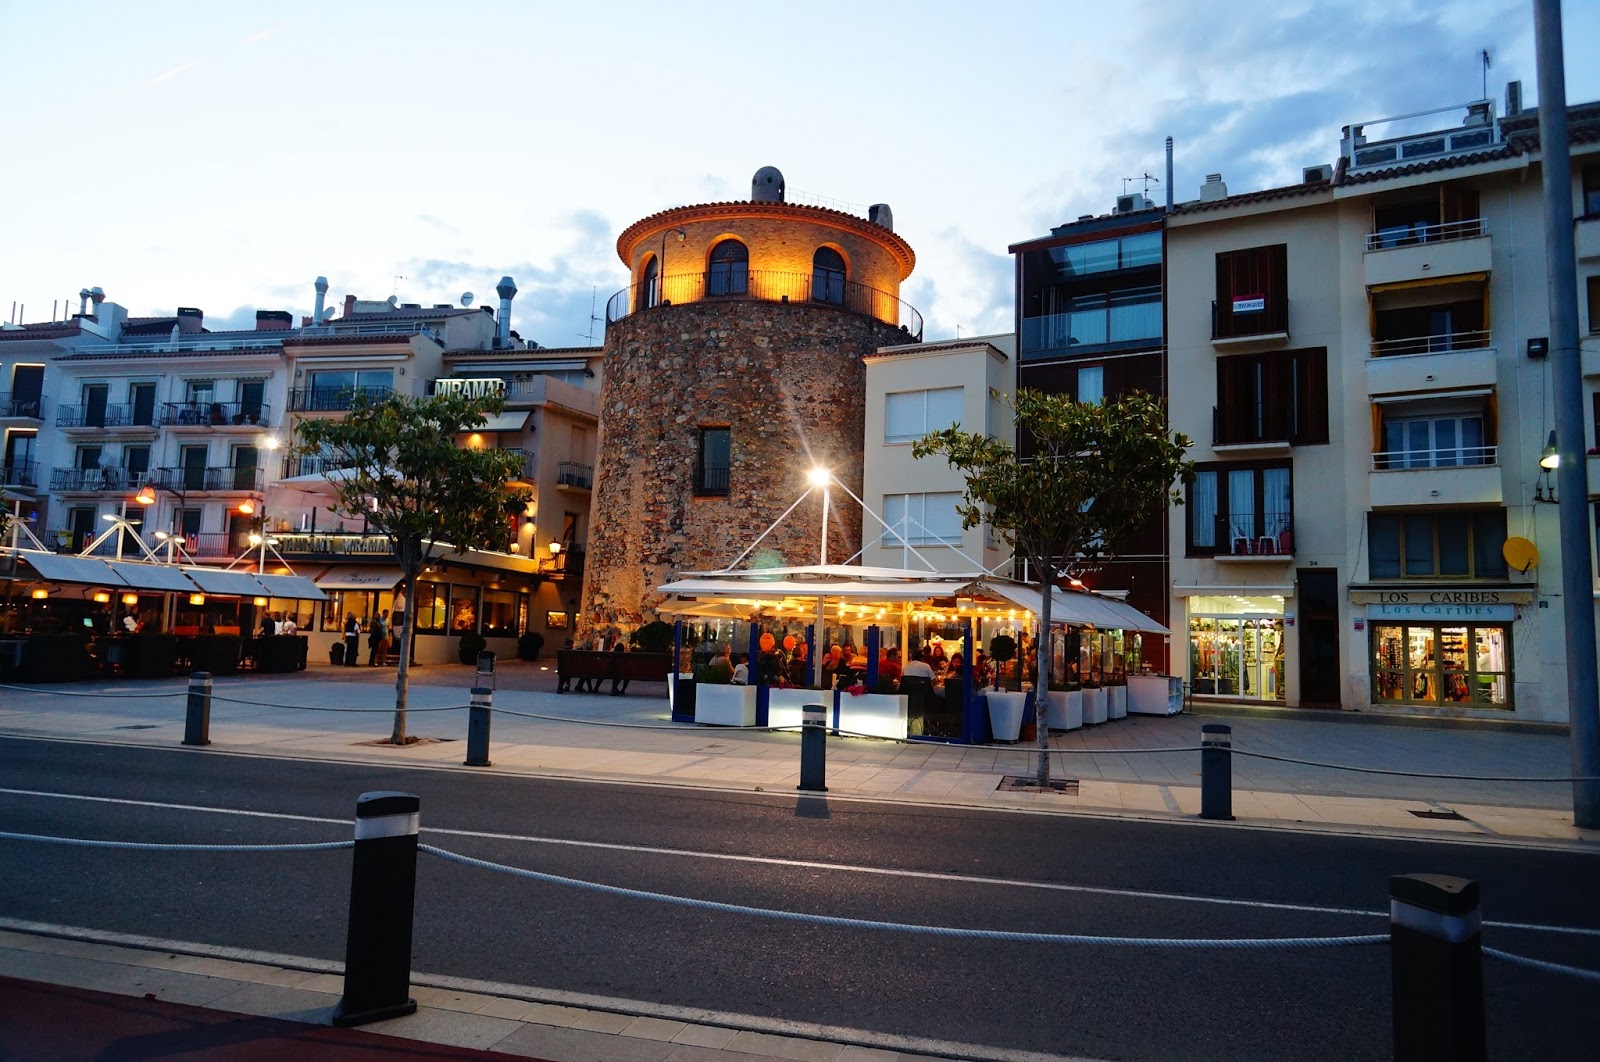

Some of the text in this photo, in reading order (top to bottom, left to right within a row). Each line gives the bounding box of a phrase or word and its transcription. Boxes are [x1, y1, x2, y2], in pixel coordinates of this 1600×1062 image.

[435, 381, 506, 399] MIRAMAR
[1380, 592, 1500, 603] LOS CARIBES
[1382, 603, 1493, 615] Los Caribes
